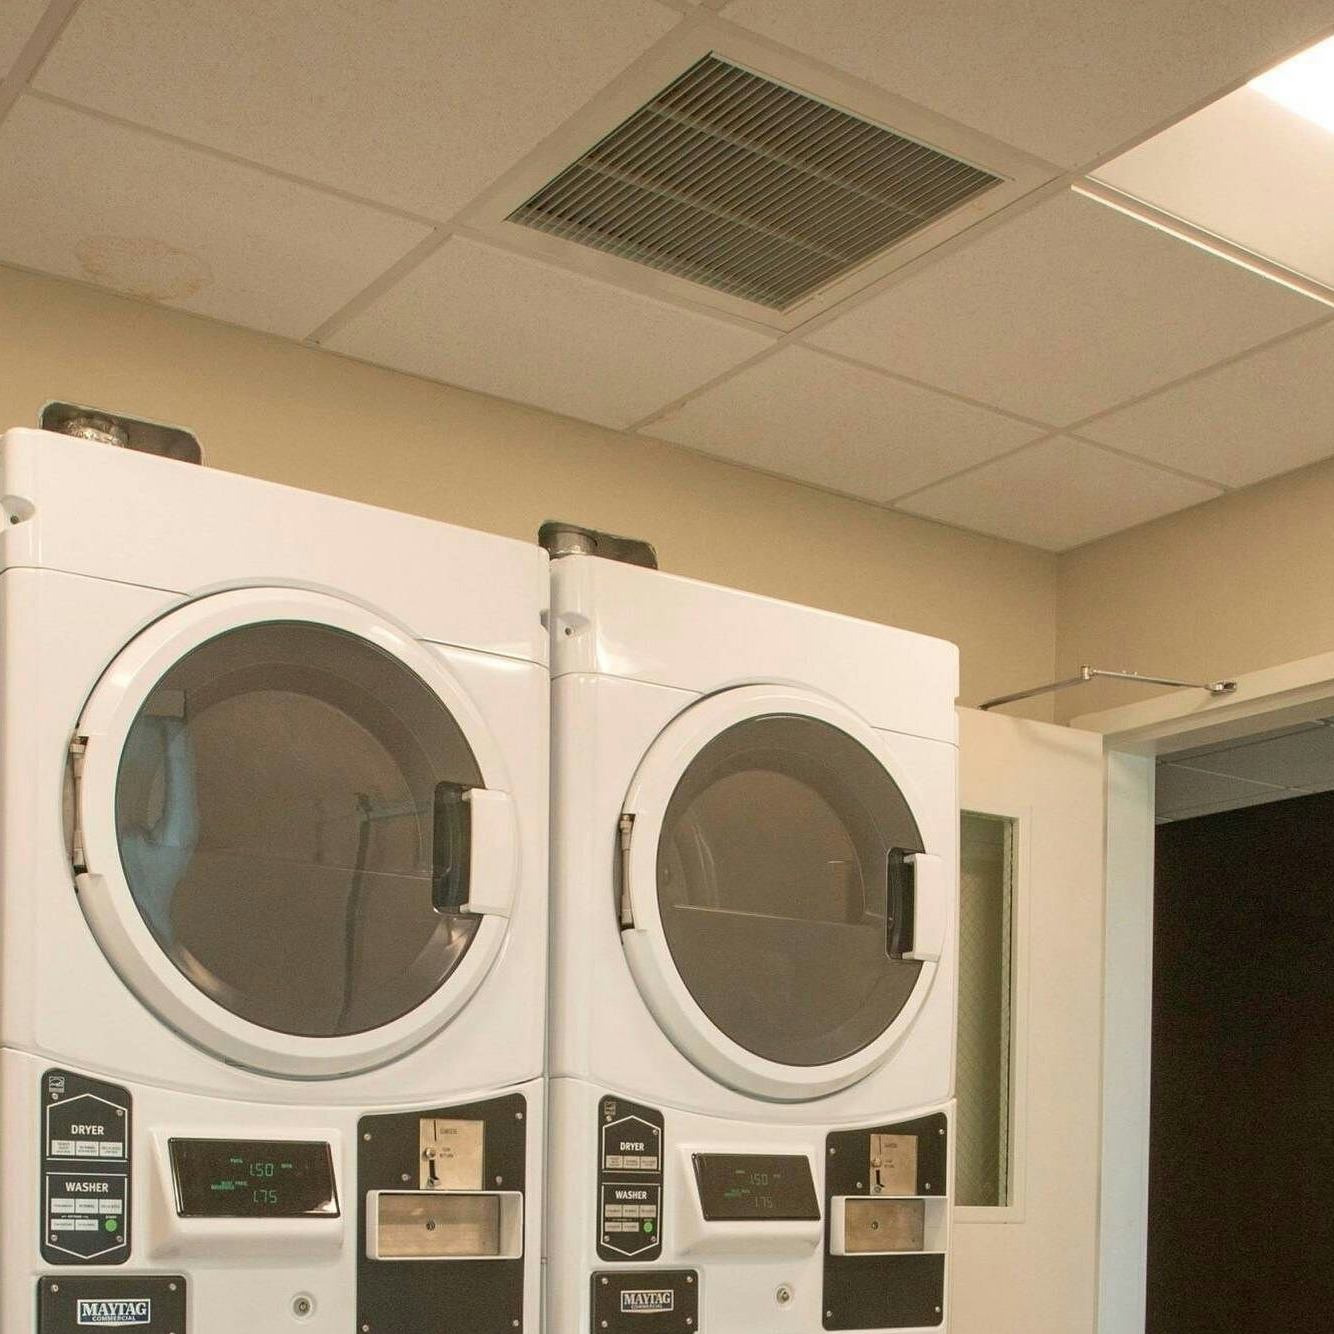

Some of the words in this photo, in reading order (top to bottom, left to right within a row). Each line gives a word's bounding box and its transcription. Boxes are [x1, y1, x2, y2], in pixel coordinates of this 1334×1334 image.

[71, 1124, 105, 1135] DRYER
[620, 1141, 645, 1151] DRYER
[65, 1182, 109, 1193] WASHER
[615, 1190, 648, 1200] WASHER
[624, 1292, 671, 1305] MAYTAG
[81, 1302, 147, 1317] MAYTAG
